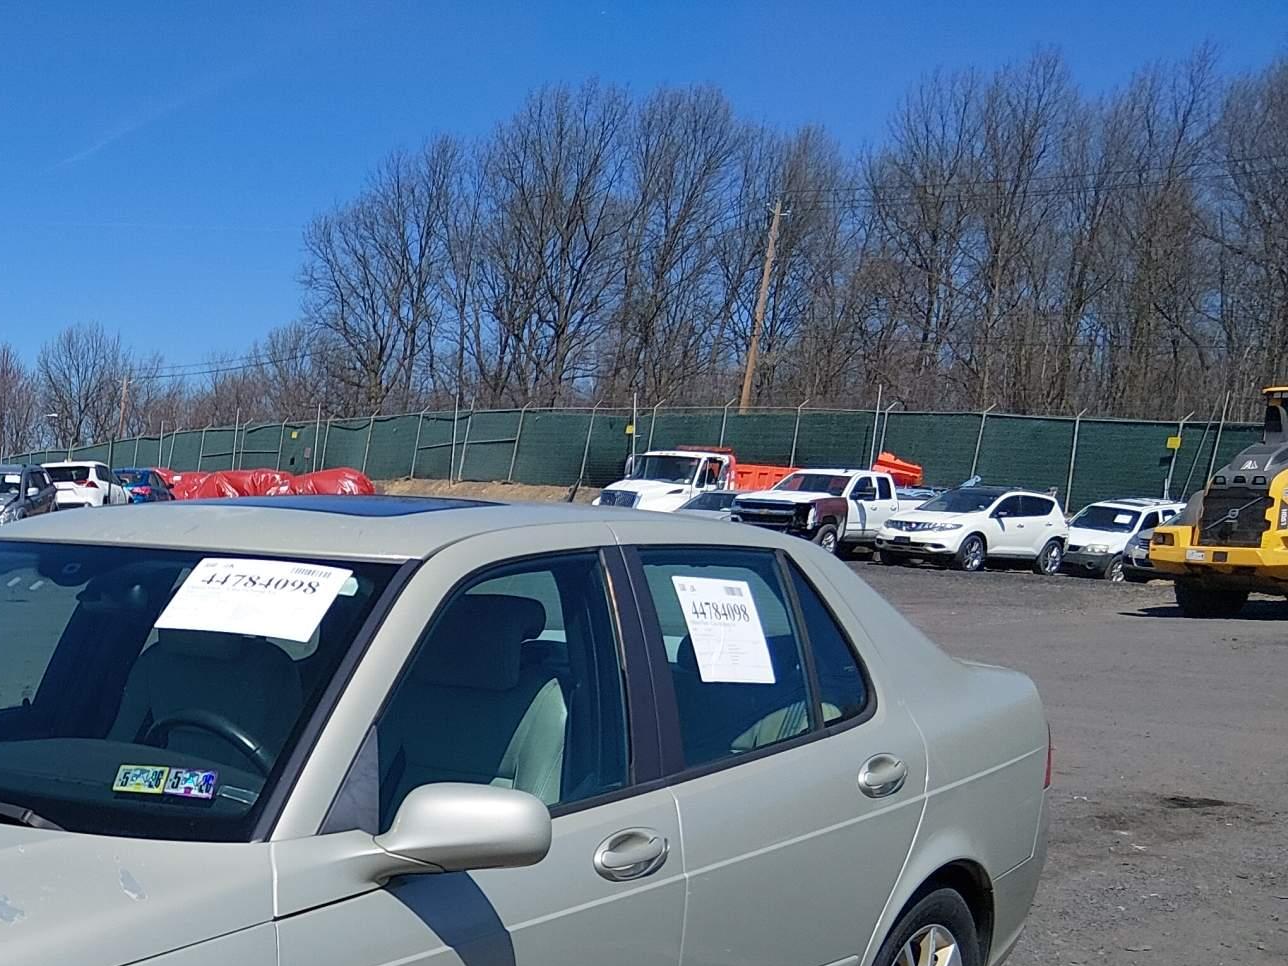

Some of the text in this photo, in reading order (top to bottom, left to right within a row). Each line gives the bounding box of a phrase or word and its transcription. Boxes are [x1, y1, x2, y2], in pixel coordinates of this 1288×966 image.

[201, 572, 321, 595] 44784098
[691, 600, 751, 623] 44784098
[120, 771, 131, 787] 5
[171, 771, 184, 789] 5
